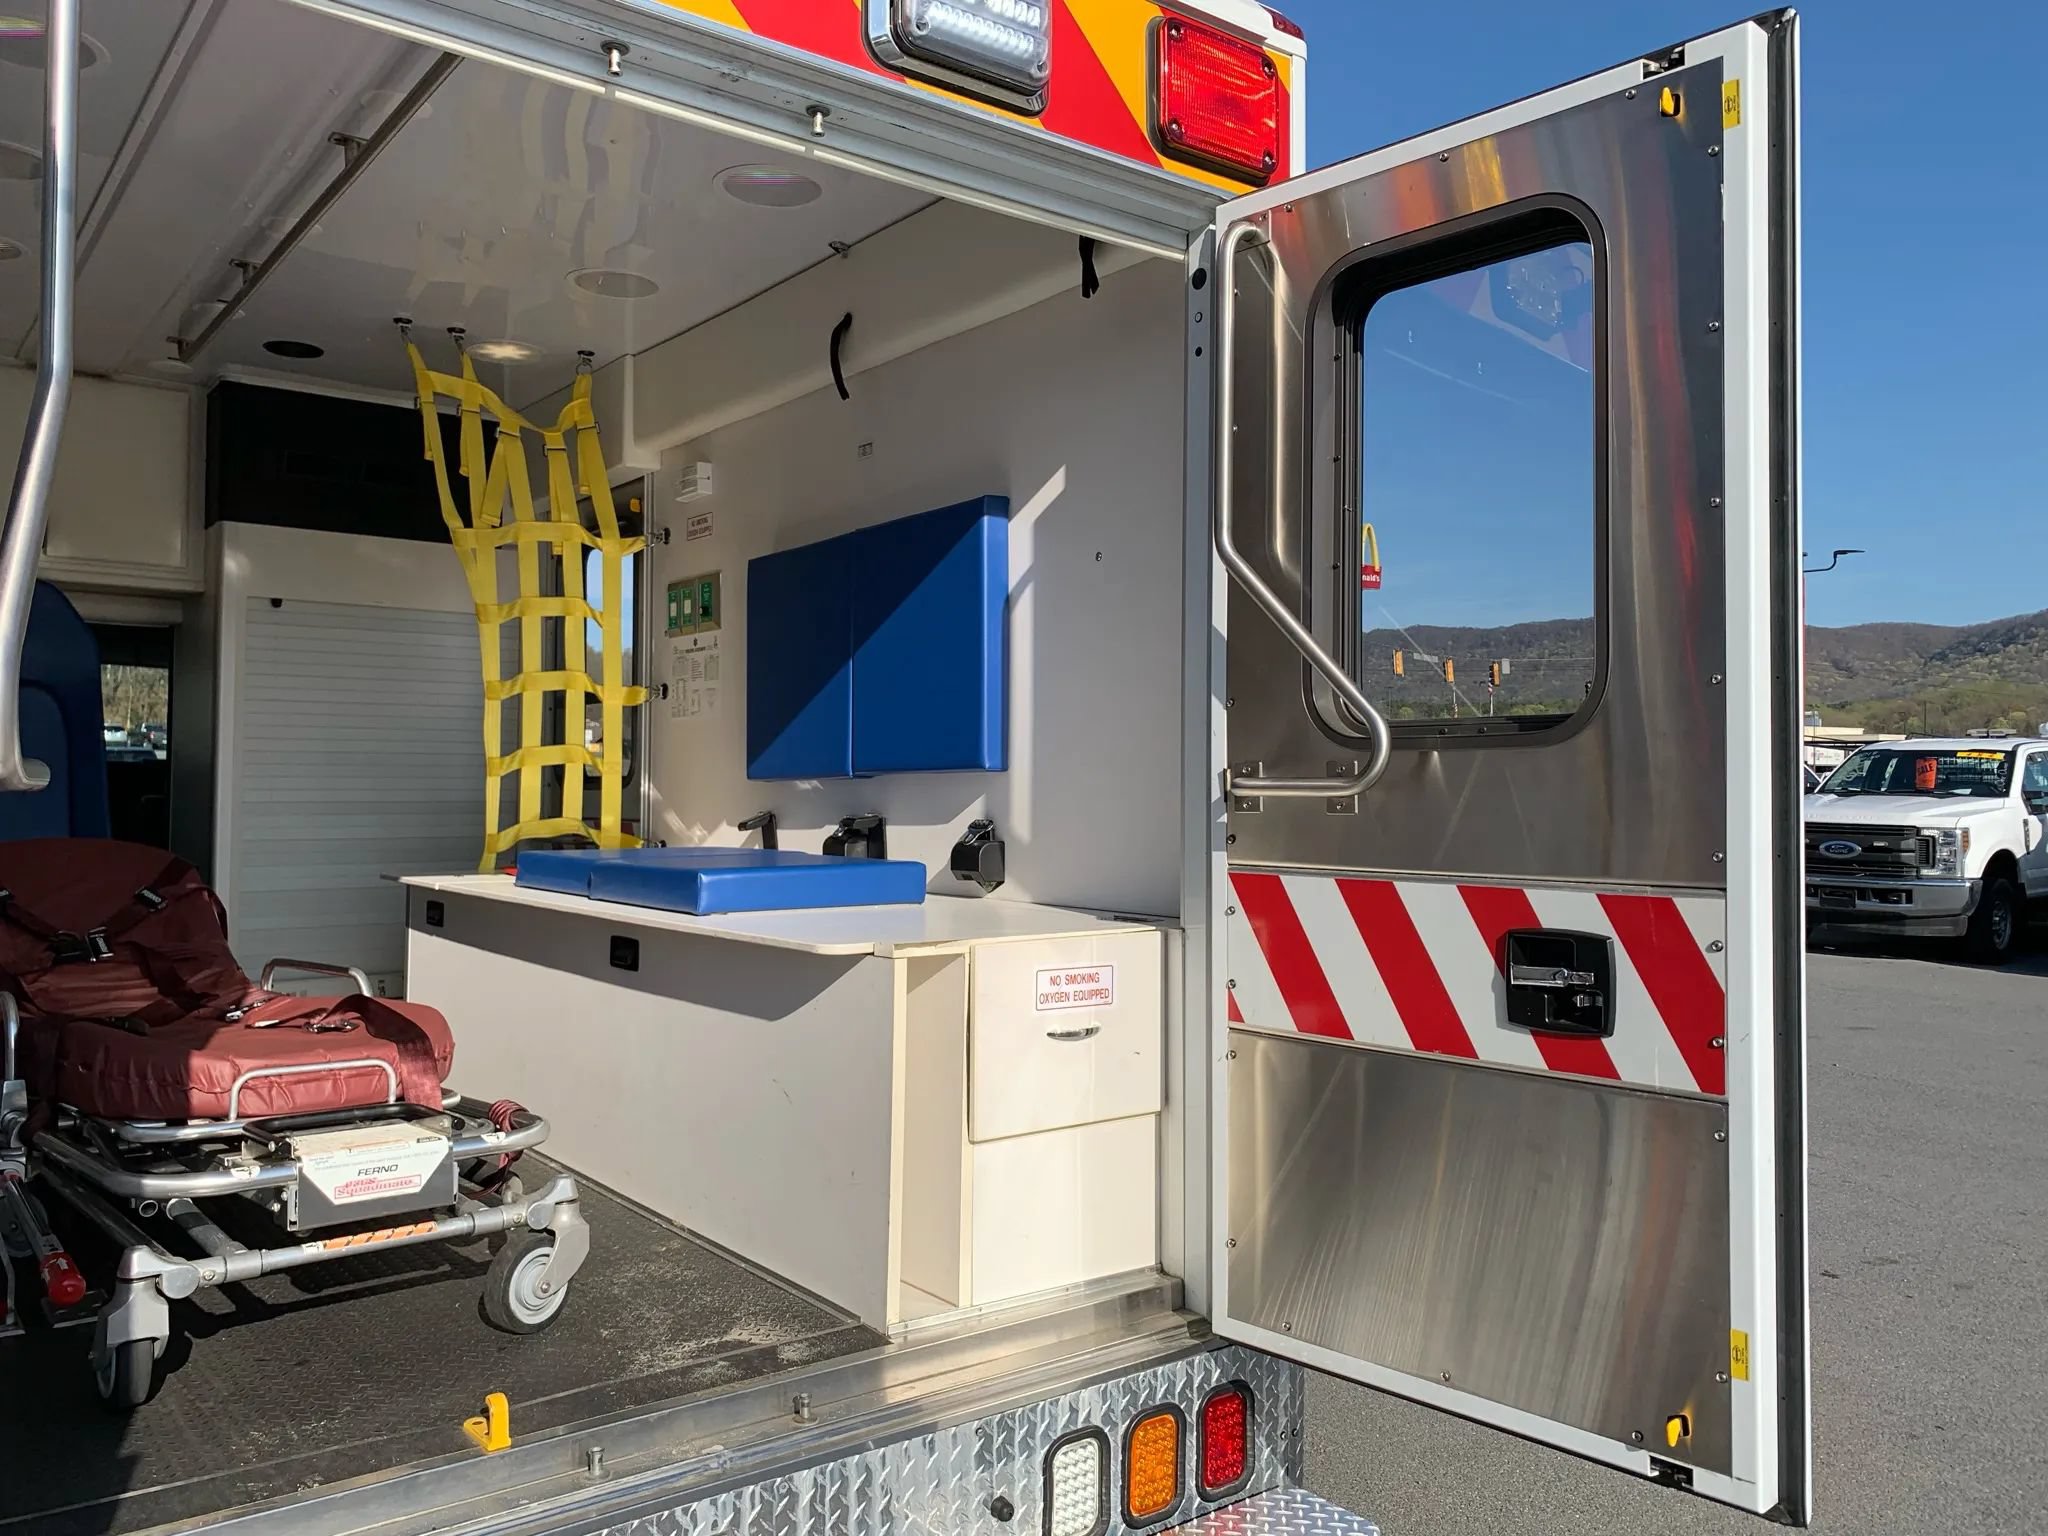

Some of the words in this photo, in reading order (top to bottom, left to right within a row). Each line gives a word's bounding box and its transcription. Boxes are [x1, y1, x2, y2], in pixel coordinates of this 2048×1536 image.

[1049, 975, 1062, 987] NO
[1064, 972, 1100, 986] SMOKING
[1039, 991, 1070, 1005] OXYGEN
[1073, 988, 1109, 1001] EQUIPPED
[357, 1164, 399, 1177] FERNO
